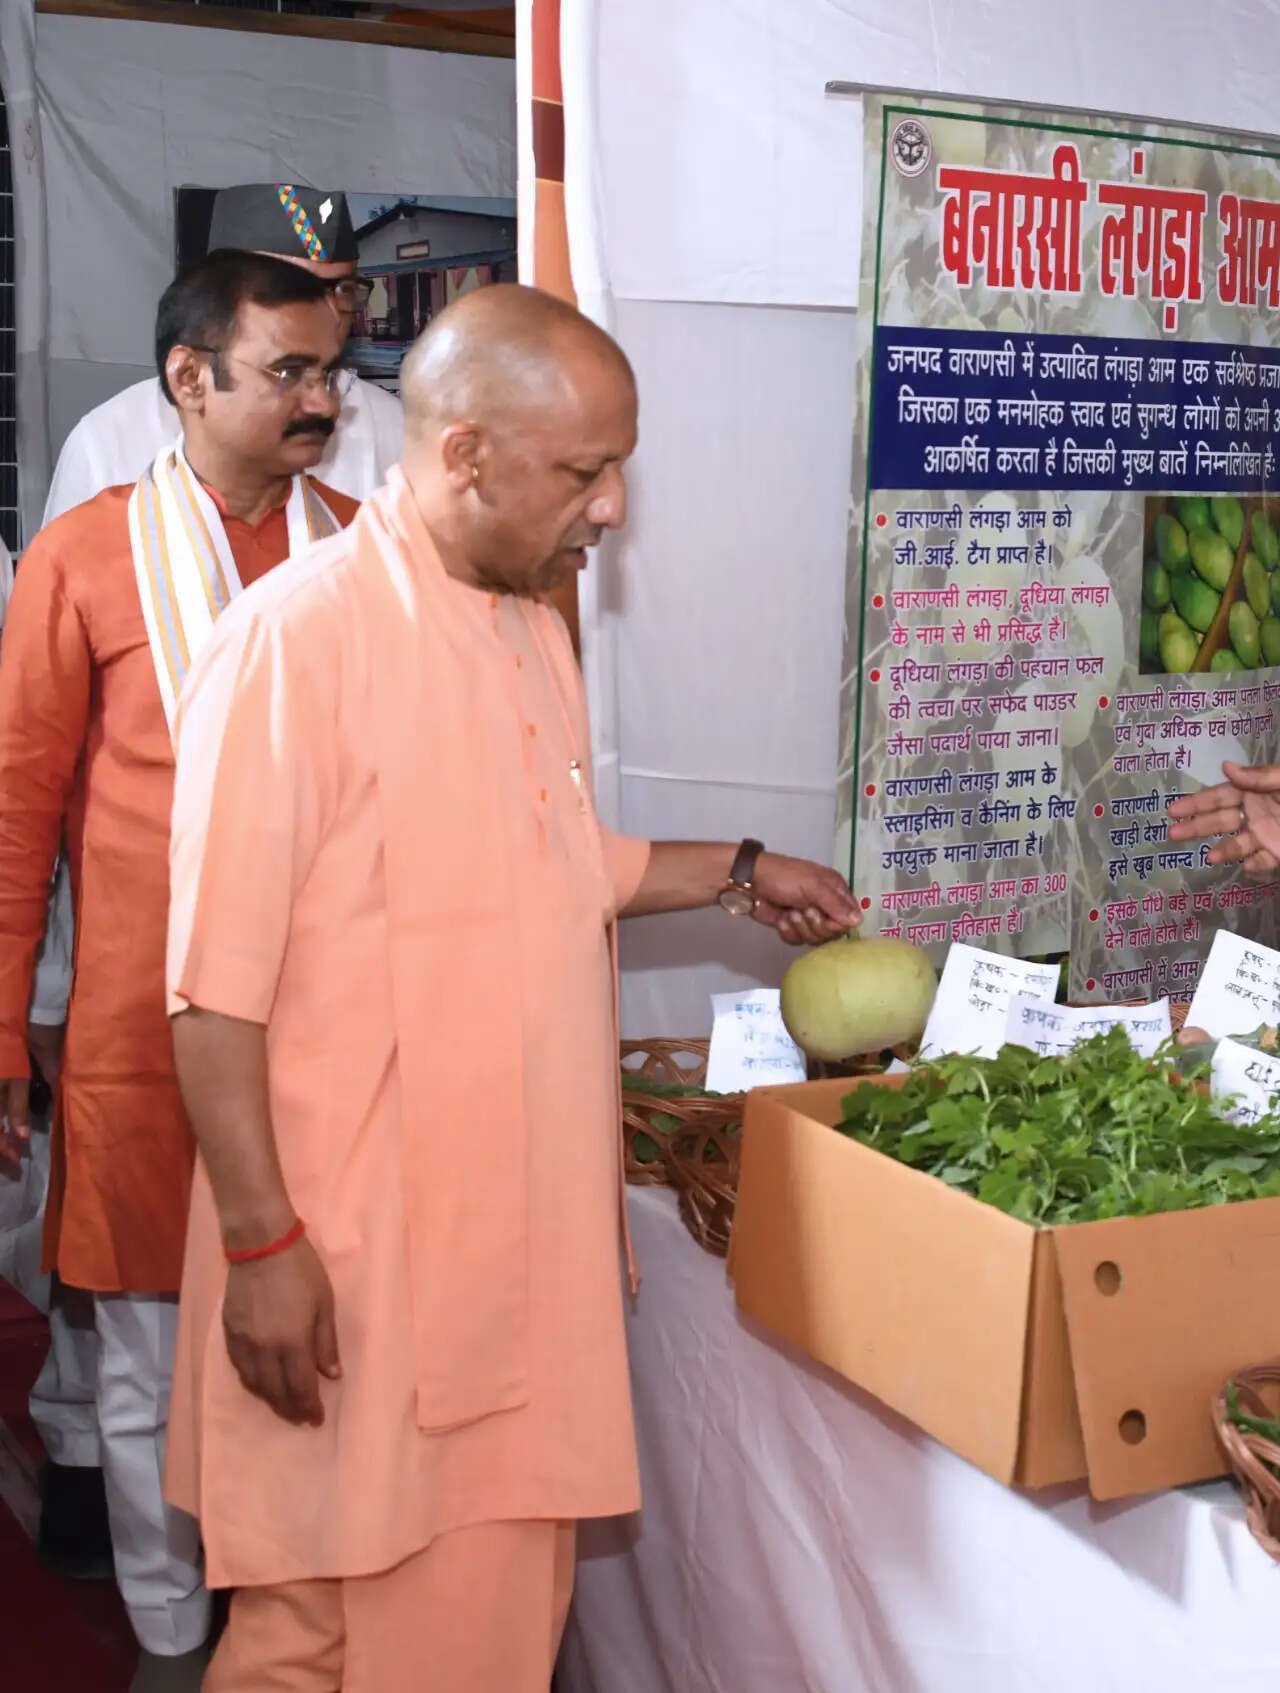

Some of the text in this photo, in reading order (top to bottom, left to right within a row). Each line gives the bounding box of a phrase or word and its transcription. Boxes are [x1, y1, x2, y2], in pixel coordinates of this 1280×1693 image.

[939, 145, 1087, 293] बनारसी
[1098, 150, 1206, 329] लंगड़ा
[887, 346, 943, 374] जनपद
[948, 339, 1016, 377] वाराणसी
[1022, 341, 1035, 378] में
[1040, 343, 1099, 380] उत्पादित
[1104, 347, 1143, 388] लंगड़ा
[1149, 357, 1176, 383] आम
[1183, 359, 1210, 385] एक
[898, 384, 959, 423] जिसका
[964, 398, 992, 425] एक
[998, 390, 1064, 428] मनमोहक
[1070, 401, 1106, 427] स्वाद
[1111, 394, 1131, 428] एवं
[1137, 403, 1177, 440] सुगन्ध
[1184, 396, 1220, 430] लोगों
[1225, 398, 1240, 431] को
[1244, 398, 1270, 432] अपनी
[924, 435, 1188, 486] आकर्षित करता है जिसकी मुख्य बातें
[896, 504, 1072, 533] वाराणसी लंगड़ा आम को
[968, 540, 1028, 565] टैग प्राप्त
[893, 581, 1110, 612] वाराणसी दूधिया लंगड़ा
[892, 618, 991, 645] के नाम से भी
[890, 655, 1104, 691] दूधिया लंगड़ा की पहचान फल
[888, 690, 1077, 720] की त्वचा पर सफेद पाउडर
[1117, 685, 1236, 712] वाराणसी लंगड़ा आम
[888, 726, 1010, 755] जैसा पदार्थ पाया
[1115, 716, 1202, 743] एवं अधिक
[1114, 747, 1169, 772] वाला होता
[886, 761, 1057, 798] वाराणसी लंगड़ा आम के
[1027, 795, 1076, 821] के लिए
[1112, 788, 1159, 817] वाराणसी
[944, 839, 1019, 863] माना जाता
[1109, 853, 1128, 880] इसे
[1159, 850, 1193, 871] पसन्द
[881, 874, 1066, 911] वाराणसी आम का 300
